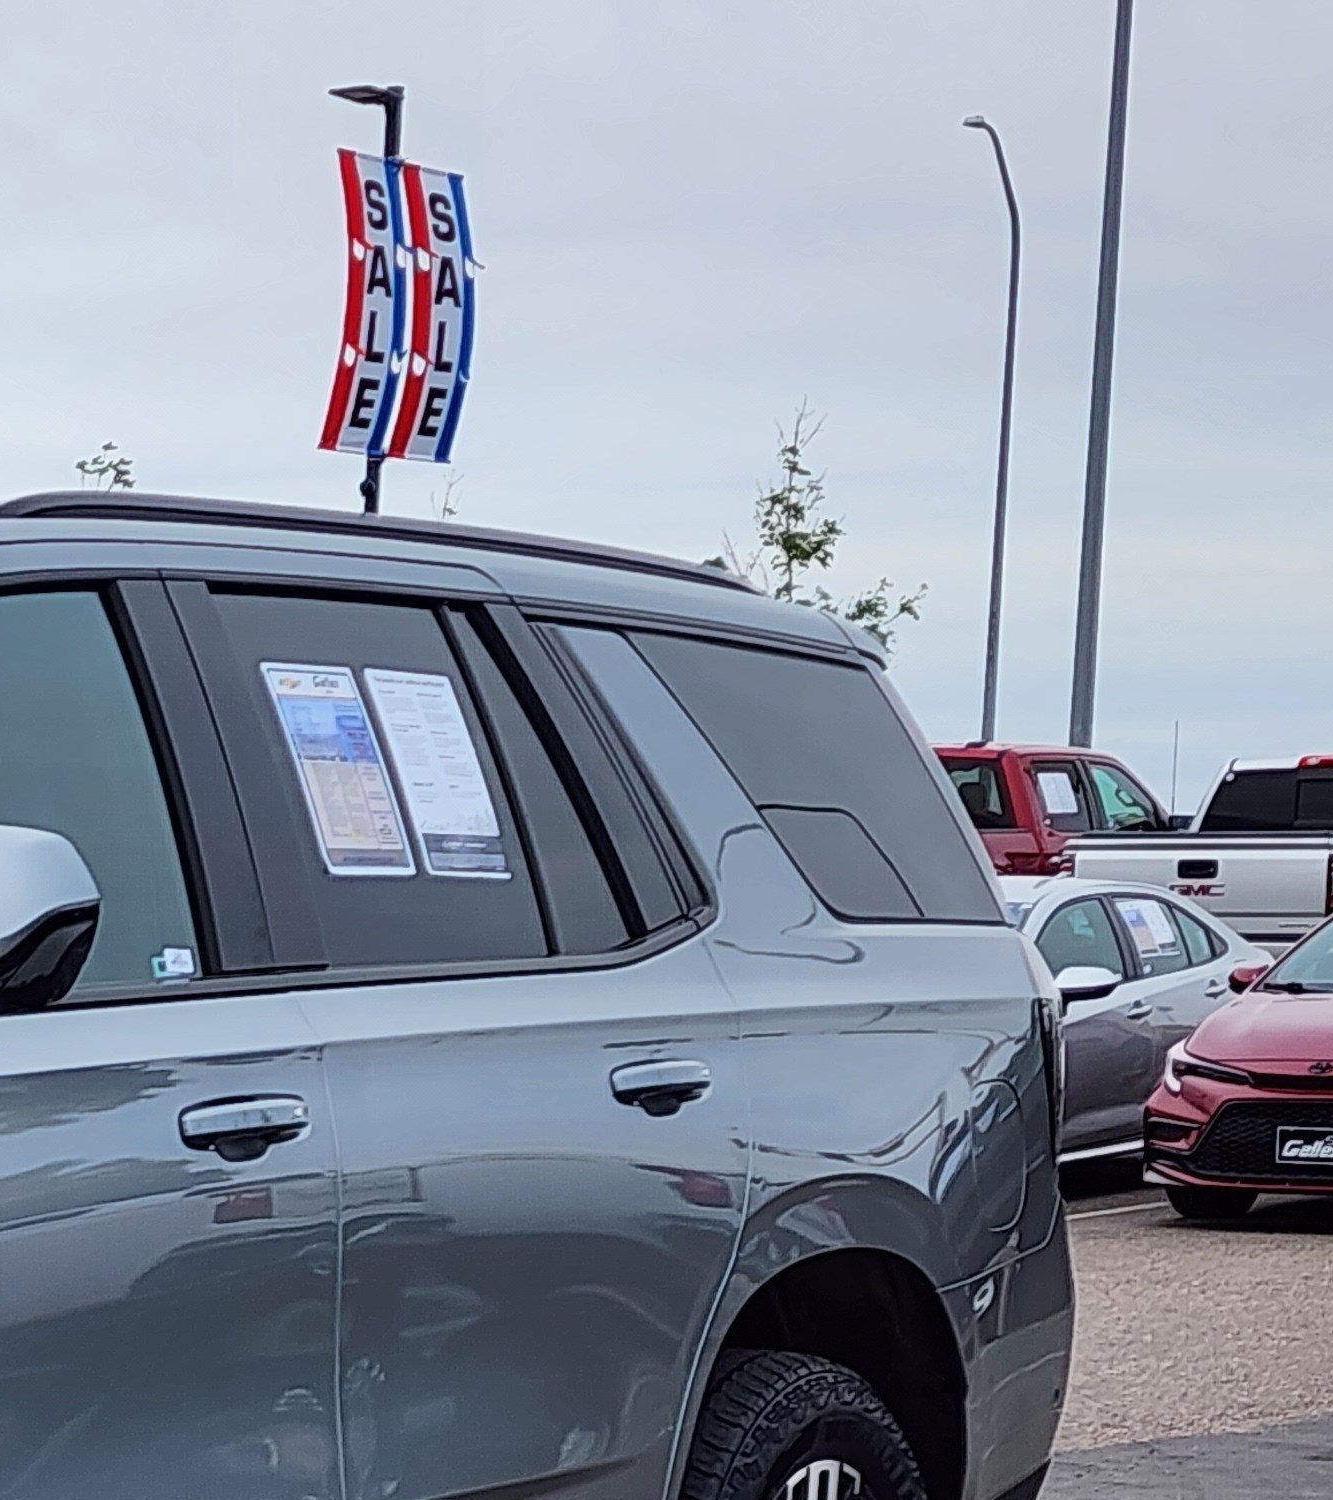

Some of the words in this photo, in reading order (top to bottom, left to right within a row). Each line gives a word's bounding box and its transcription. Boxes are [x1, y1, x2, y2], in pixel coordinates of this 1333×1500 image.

[348, 179, 393, 429] SALE
[416, 191, 461, 437] SALE
[1169, 884, 1226, 897] GMC
